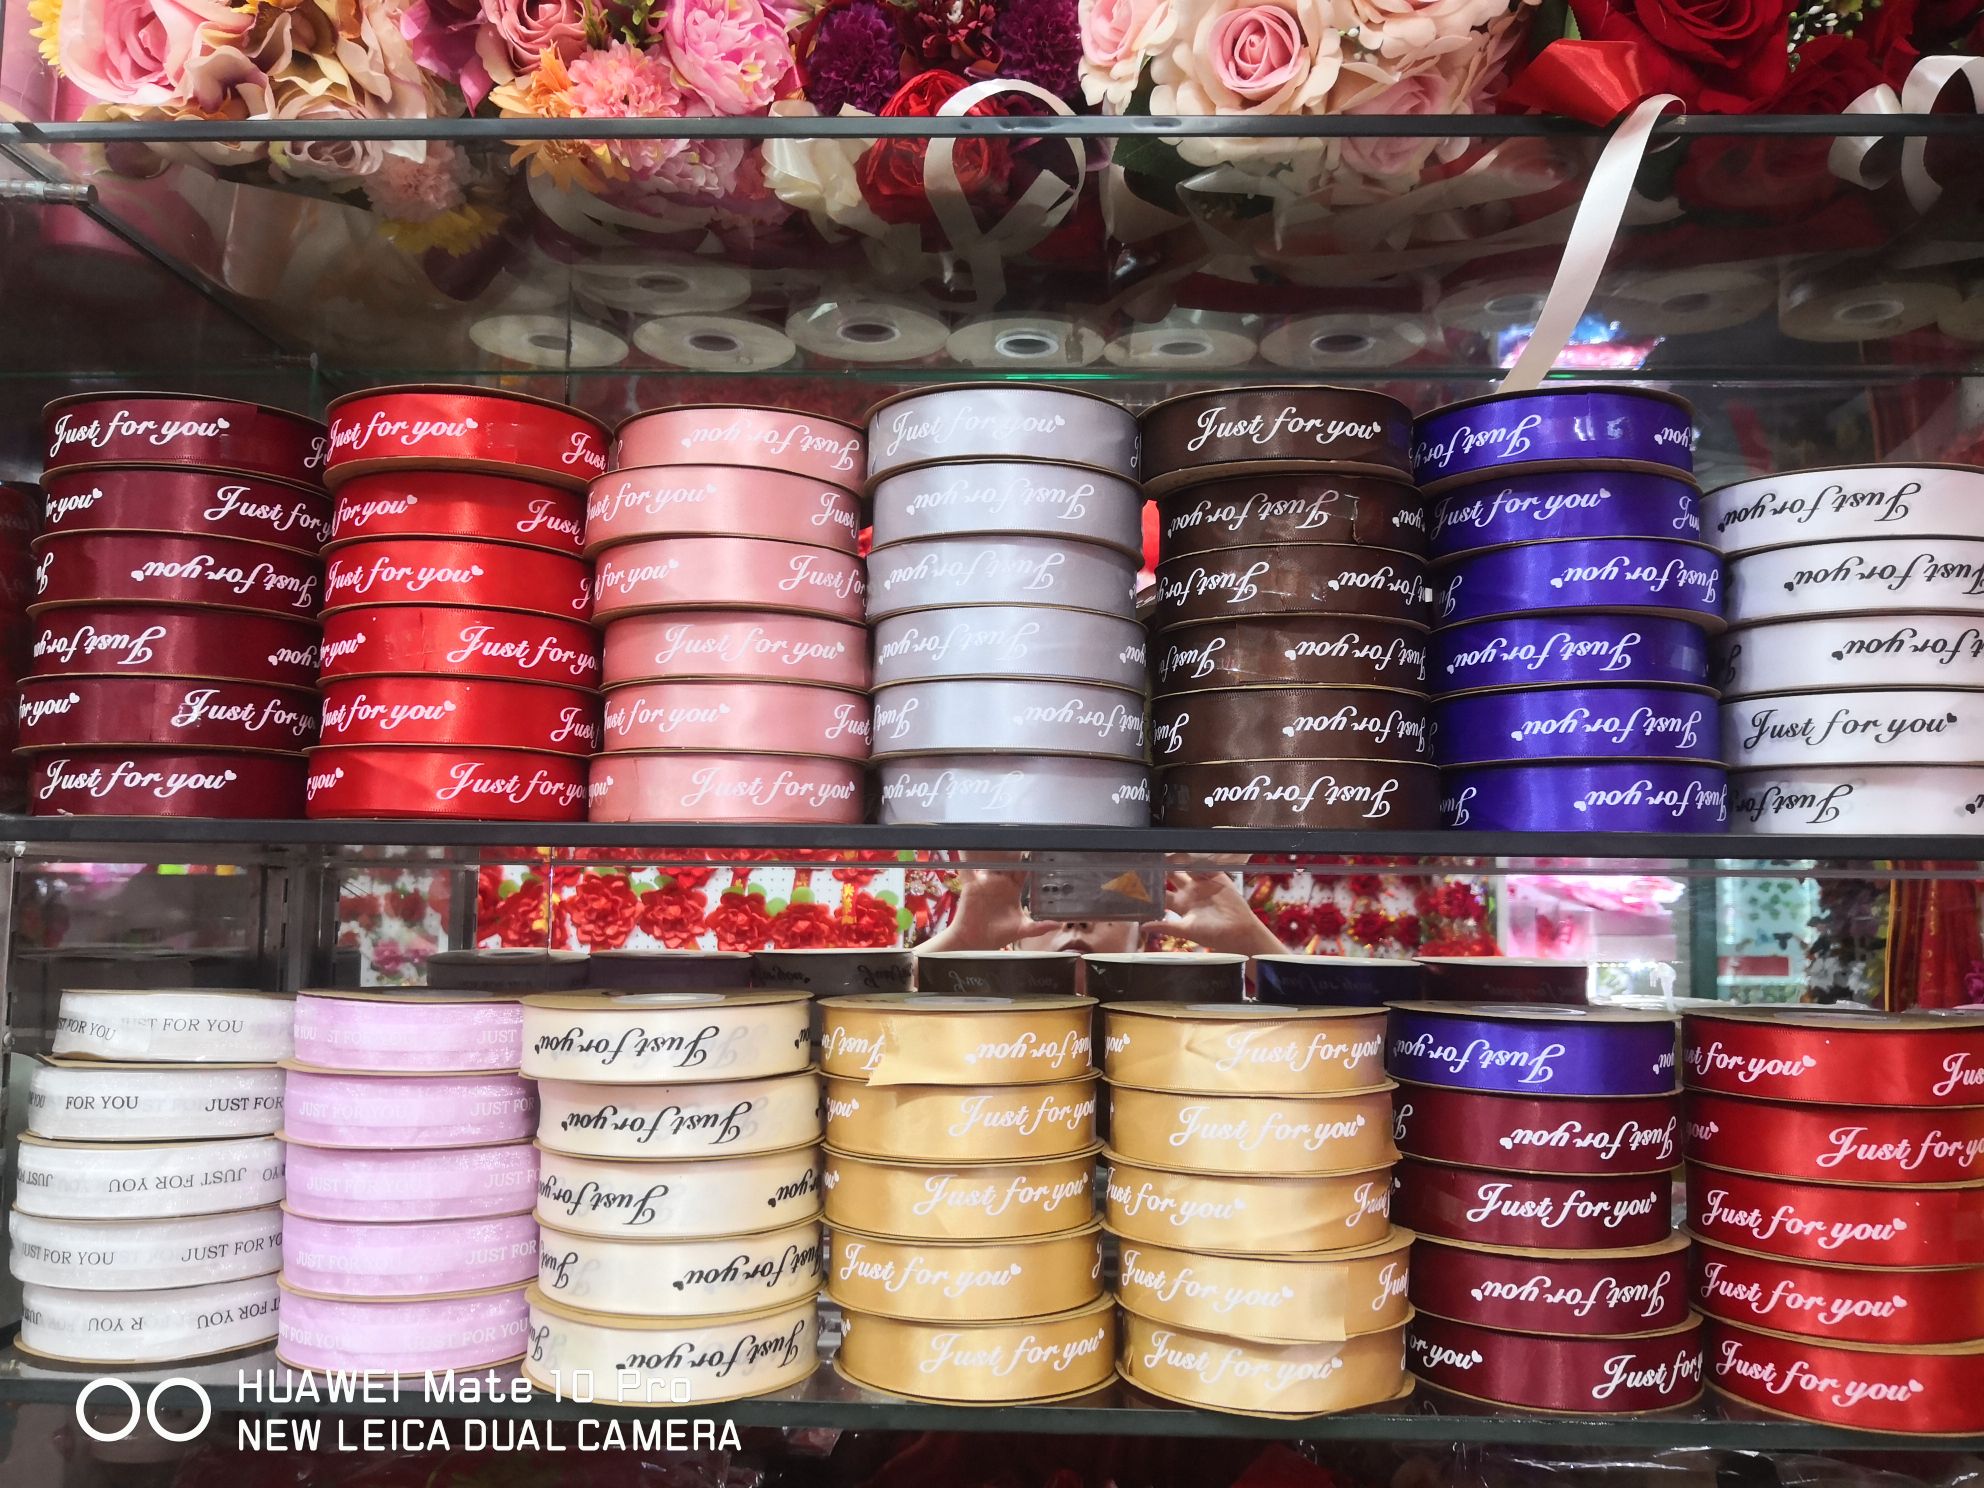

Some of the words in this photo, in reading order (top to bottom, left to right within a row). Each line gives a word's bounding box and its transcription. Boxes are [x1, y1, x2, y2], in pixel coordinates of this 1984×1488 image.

[50, 415, 101, 457] Just
[91, 411, 157, 447] for
[150, 421, 220, 445] you
[327, 418, 361, 462] Just
[353, 412, 408, 449] for
[401, 421, 469, 445] you
[692, 420, 748, 442] you
[748, 425, 808, 454] for
[887, 411, 942, 456] Just
[934, 407, 994, 443] for
[992, 415, 1056, 441] you
[1187, 407, 1264, 451] Just
[1252, 407, 1323, 444] for
[1316, 421, 1374, 444] you
[801, 437, 859, 470] Just
[914, 480, 969, 508] you
[965, 478, 1030, 513] for
[1020, 484, 1094, 519] Just
[1205, 493, 1268, 531] for
[1259, 490, 1339, 529] Just
[1724, 493, 1775, 523] you
[1769, 485, 1842, 523] for
[1834, 482, 1921, 521] Just
[1171, 500, 1211, 531] you
[1430, 497, 1484, 540] Just
[1475, 489, 1541, 527] for
[1534, 490, 1602, 520] you
[143, 555, 215, 579] you
[205, 563, 274, 594] for
[326, 560, 362, 601] Just
[355, 557, 412, 593] for
[407, 568, 474, 591] you
[891, 554, 938, 582] you
[932, 551, 996, 584] for
[983, 552, 1065, 589] Just
[1563, 556, 1629, 581] you
[1624, 559, 1683, 592] for
[264, 576, 317, 607] Just
[1677, 568, 1719, 603] Just
[656, 624, 729, 663] Just
[721, 628, 789, 662] for
[783, 644, 837, 664] you
[884, 629, 918, 657] you
[913, 624, 969, 661] for
[961, 622, 1039, 661] Just
[1296, 633, 1359, 656] you
[1352, 638, 1403, 671] for
[1455, 638, 1507, 668] you
[1500, 633, 1570, 670] for
[1560, 633, 1641, 671] Just
[1398, 646, 1426, 680] Just
[1294, 706, 1357, 731] you
[1352, 710, 1402, 743] for
[1397, 717, 1425, 752] Just
[1523, 708, 1589, 734] you
[1583, 707, 1652, 743] for
[1644, 711, 1702, 748] Just
[1743, 709, 1814, 749] Just
[1805, 709, 1882, 745] for
[1874, 715, 1946, 743] you
[40, 759, 101, 799] Just
[91, 761, 162, 797] for
[154, 775, 227, 798] you
[681, 768, 762, 807] Just
[754, 771, 812, 805] for
[810, 784, 852, 807] you
[1215, 776, 1271, 801] you
[1264, 775, 1335, 812] for
[1587, 780, 1653, 805] you
[1325, 778, 1399, 818] Just
[1645, 781, 1702, 817] for
[1696, 783, 1727, 821] Just
[90, 1022, 116, 1040] YOU
[162, 1019, 200, 1032] FOR
[206, 1019, 244, 1033] YOU
[540, 1027, 583, 1052] you
[578, 1028, 645, 1065] for
[636, 1026, 720, 1068] Just
[1216, 1029, 1298, 1071] Just
[1290, 1033, 1349, 1072] for
[1343, 1039, 1379, 1069] you
[1397, 1034, 1433, 1056] you
[1428, 1039, 1490, 1073] for
[1480, 1044, 1565, 1083] Just
[66, 1096, 95, 1109] FOR
[101, 1096, 139, 1109] YOU
[206, 1098, 255, 1112] JUST
[569, 1106, 618, 1130] you
[611, 1106, 681, 1143] for
[672, 1101, 752, 1144] Just
[1169, 1107, 1249, 1146] Just
[1240, 1113, 1310, 1149] for
[1304, 1121, 1358, 1150] you
[1511, 1121, 1582, 1147] you
[1575, 1121, 1637, 1159] for
[1631, 1116, 1676, 1160] Just
[108, 1178, 148, 1193] YOU
[155, 1175, 193, 1190] FOR
[200, 1167, 247, 1185] JUST
[913, 1174, 993, 1215] Just
[985, 1176, 1050, 1215] for
[1044, 1178, 1084, 1211] you
[1467, 1184, 1551, 1222] Just
[1542, 1190, 1611, 1228] for
[1604, 1194, 1651, 1227] you
[1702, 1190, 1762, 1225] Just
[1753, 1205, 1825, 1239] for
[1818, 1222, 1895, 1249] you
[43, 1249, 71, 1264] FOR
[78, 1252, 114, 1265] YOU
[182, 1244, 229, 1262] JUST
[235, 1238, 264, 1255] FOR
[841, 1243, 894, 1280] Just
[885, 1257, 948, 1291] for
[944, 1267, 1011, 1298] you
[1122, 1250, 1167, 1286] Just
[1158, 1269, 1217, 1301] for
[1213, 1285, 1283, 1313] you
[1482, 1276, 1551, 1301] you
[239, 1301, 267, 1319] FOR
[1545, 1278, 1615, 1316] for
[1607, 1271, 1670, 1317] Just
[1701, 1262, 1761, 1301] Just
[1751, 1280, 1825, 1314] for
[1818, 1298, 1895, 1324] you
[88, 1318, 124, 1331] YOU
[197, 1311, 234, 1329] YOU
[627, 1343, 695, 1369] you
[690, 1335, 756, 1377] for
[748, 1320, 804, 1368] Just
[919, 1334, 1000, 1374] Just
[993, 1336, 1058, 1376] for
[1054, 1337, 1099, 1371] you
[1145, 1331, 1210, 1368] Just
[1200, 1348, 1270, 1384] for
[1265, 1362, 1332, 1391] you
[1716, 1341, 1776, 1376] Just
[1767, 1361, 1840, 1394] for
[1832, 1379, 1911, 1407] you
